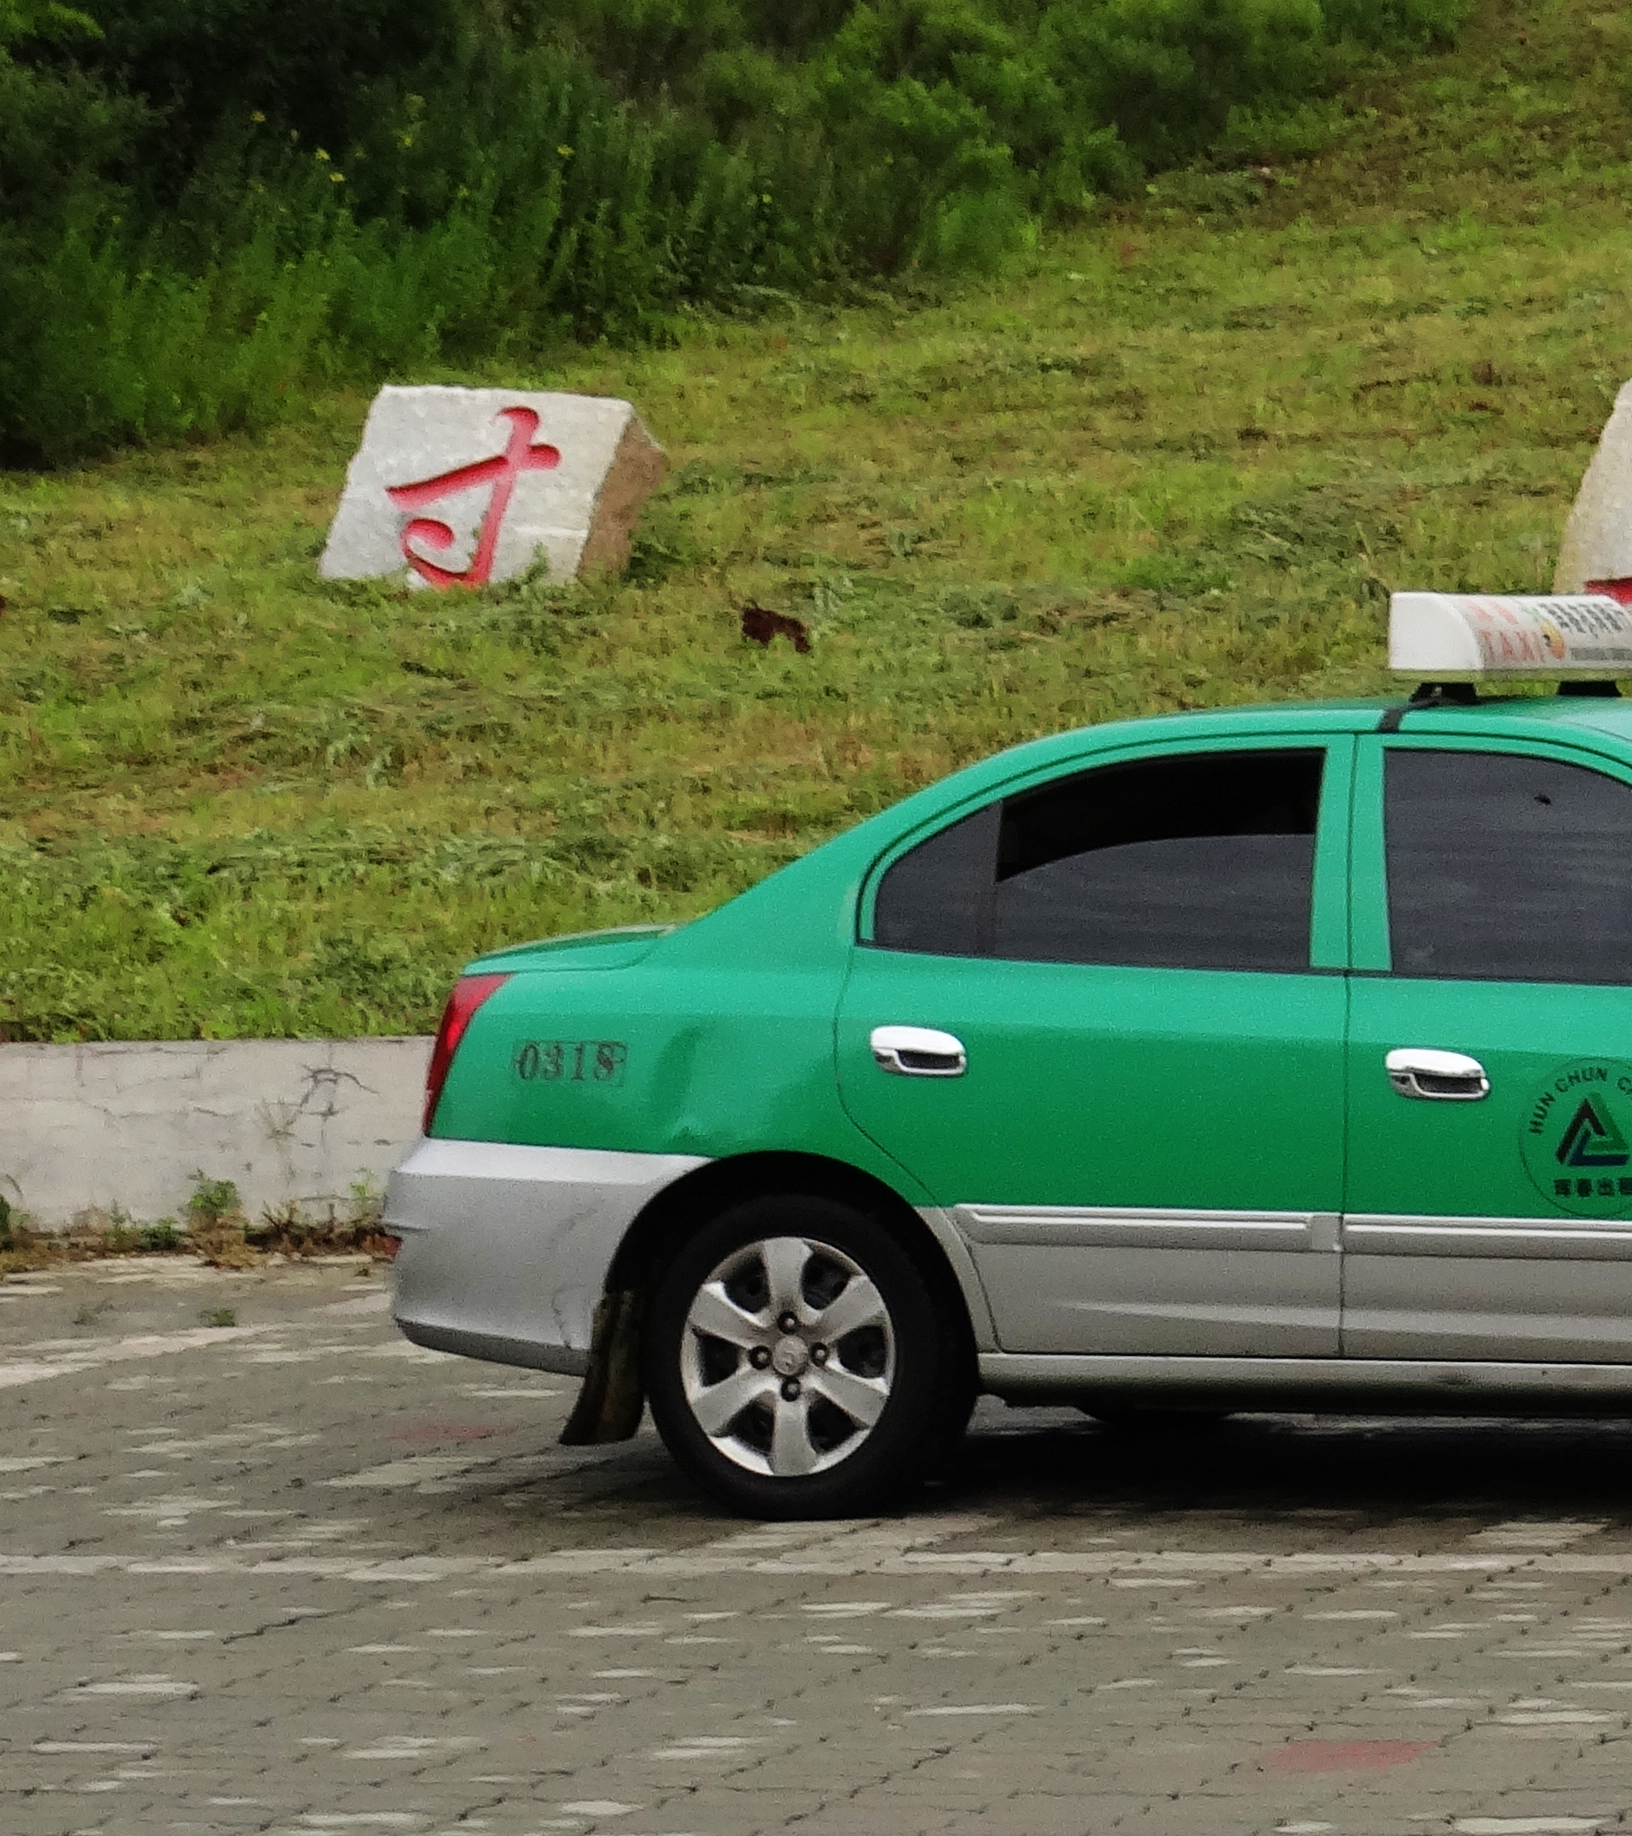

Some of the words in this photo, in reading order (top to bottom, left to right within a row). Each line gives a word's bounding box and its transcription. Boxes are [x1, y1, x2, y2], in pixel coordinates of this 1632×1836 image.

[386, 405, 561, 590] 寸
[1477, 628, 1546, 663] TAXI
[1554, 1066, 1609, 1094] CHUN
